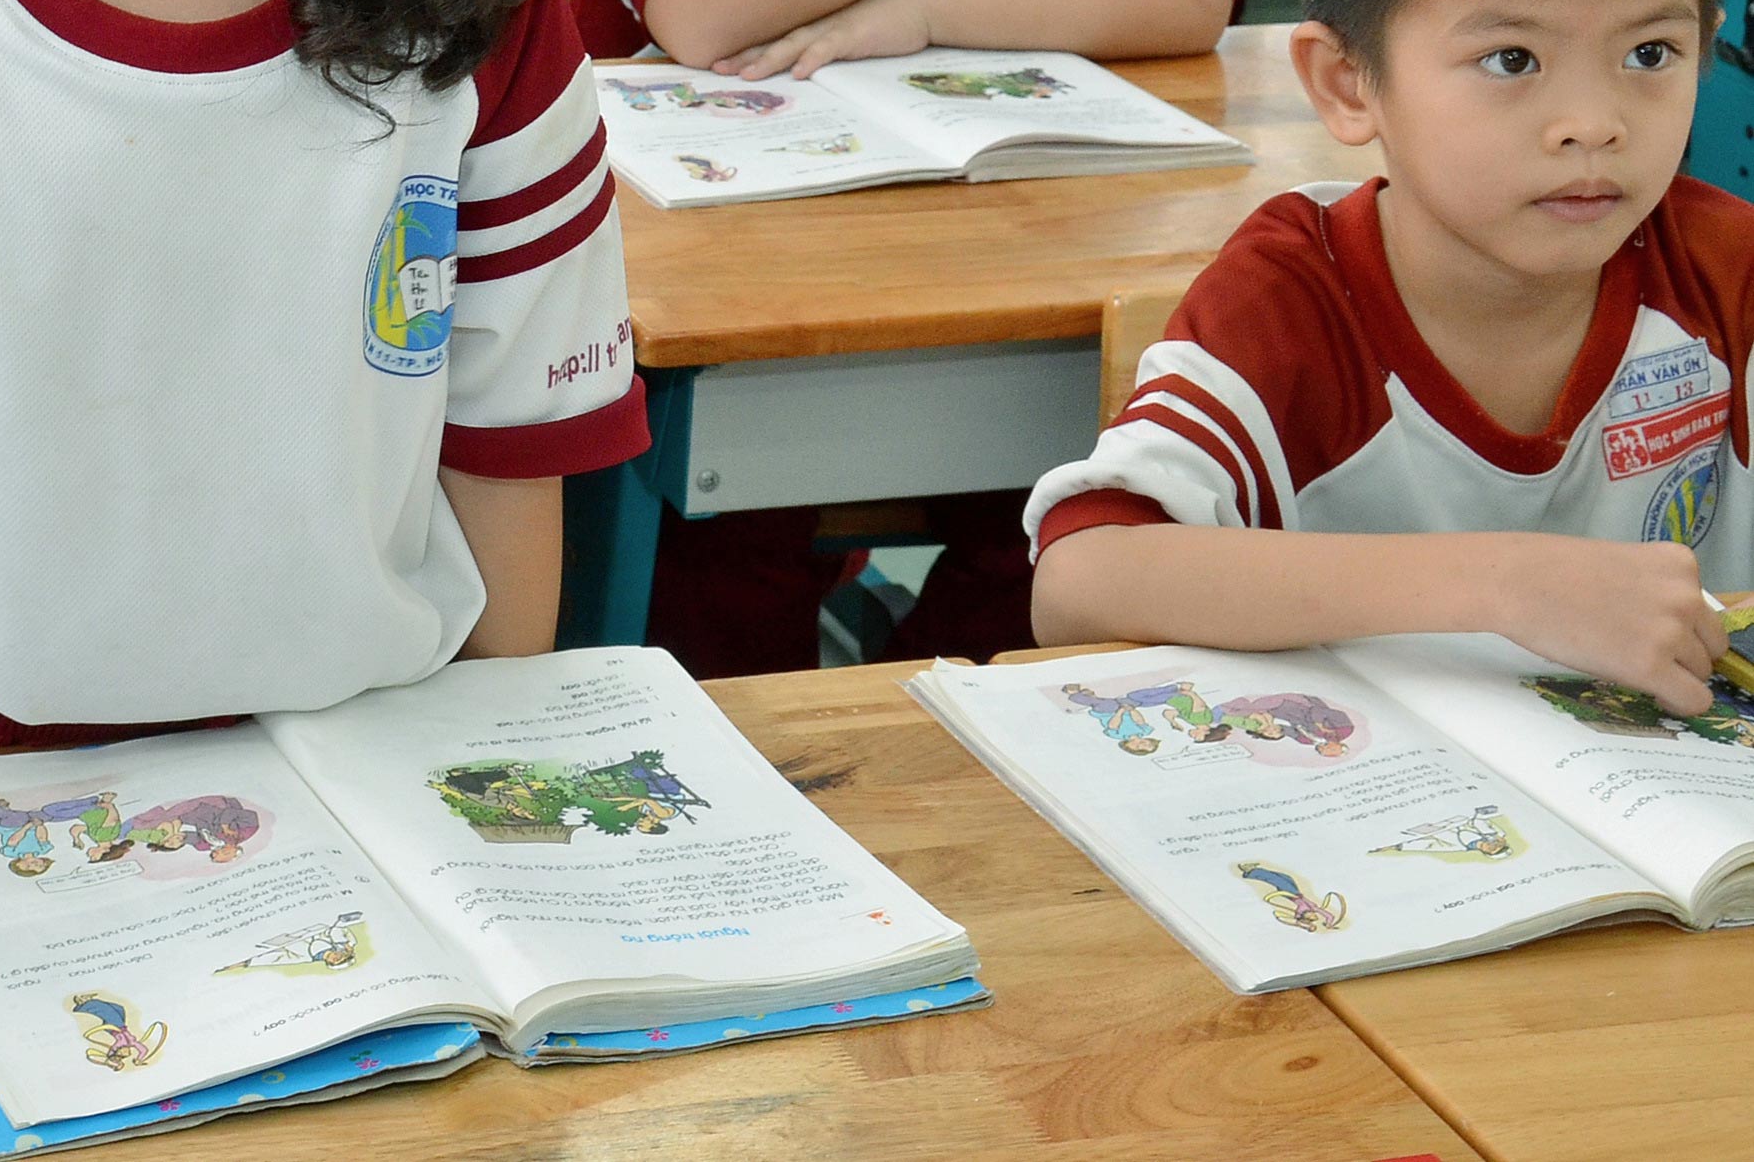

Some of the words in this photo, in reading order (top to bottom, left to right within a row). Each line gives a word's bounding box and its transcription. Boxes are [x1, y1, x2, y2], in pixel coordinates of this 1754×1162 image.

[404, 183, 435, 200] HỌC
[1651, 363, 1680, 381] VĂN
[1674, 380, 1695, 401] 13
[1647, 433, 1671, 453] HỌC
[621, 935, 644, 943] na
